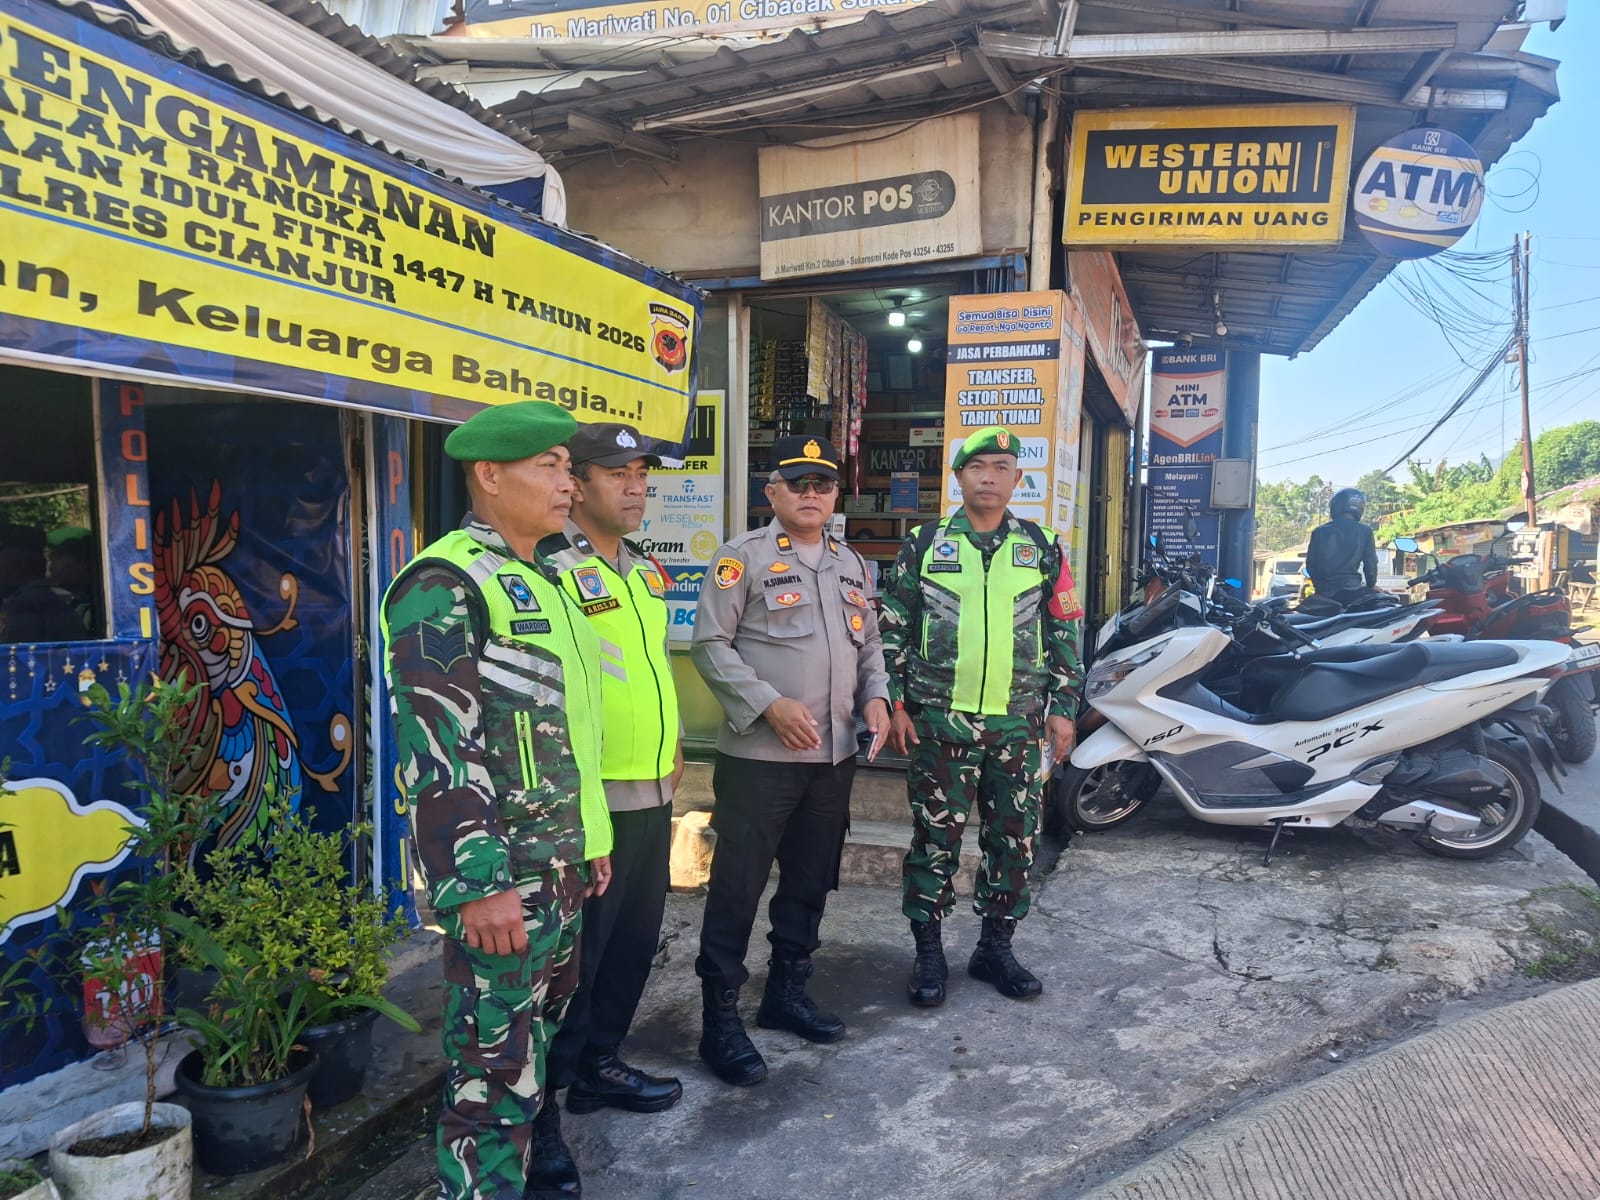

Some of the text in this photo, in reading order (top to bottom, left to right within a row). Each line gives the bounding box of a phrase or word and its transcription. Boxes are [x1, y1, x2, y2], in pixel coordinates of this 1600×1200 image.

[567, 10, 658, 38] Mariwati
[662, 8, 700, 29] No.
[707, 2, 732, 24] 01
[740, 0, 835, 20] Cibadak
[0, 24, 496, 259] ENGAMANAN
[1411, 143, 1433, 153] BANK
[1105, 141, 1292, 169] WESTERN
[1158, 169, 1290, 194] UNION
[1361, 160, 1475, 209] ATM
[187, 149, 386, 242] RANGKA
[768, 183, 914, 228] KANTOR POS
[1078, 211, 1329, 227] PENGIRIMAN UANG
[140, 167, 259, 231] IDUL
[272, 212, 384, 270] FITRI
[393, 253, 465, 293] 1447
[474, 279, 494, 304] H
[502, 288, 593, 336] TAHUN
[597, 322, 646, 353] 2026
[184, 220, 397, 304] CIANJUR
[882, 250, 899, 261] Kode
[900, 249, 912, 258] Pos
[936, 243, 955, 254] 43255
[959, 310, 996, 322] Semua
[1023, 304, 1053, 318] Disini
[137, 279, 434, 375] Keluarga
[452, 353, 645, 422] Bahagia...!
[956, 346, 981, 360] JASA
[983, 343, 1046, 358] PERBANKAN
[1168, 354, 1217, 364] BANK BRI
[967, 368, 1037, 386] TRANSFER,
[958, 388, 1045, 406] SETOR TUNAI,
[1175, 383, 1200, 392] MINI
[1167, 393, 1208, 406] ATM
[960, 408, 1041, 426] TARIK TUNAI
[1165, 472, 1198, 481] Melayani
[662, 495, 714, 503] TRANSFAST
[1143, 724, 1184, 746] 150
[1294, 721, 1360, 748] Automatic Sporty
[1306, 719, 1385, 763] PCX
